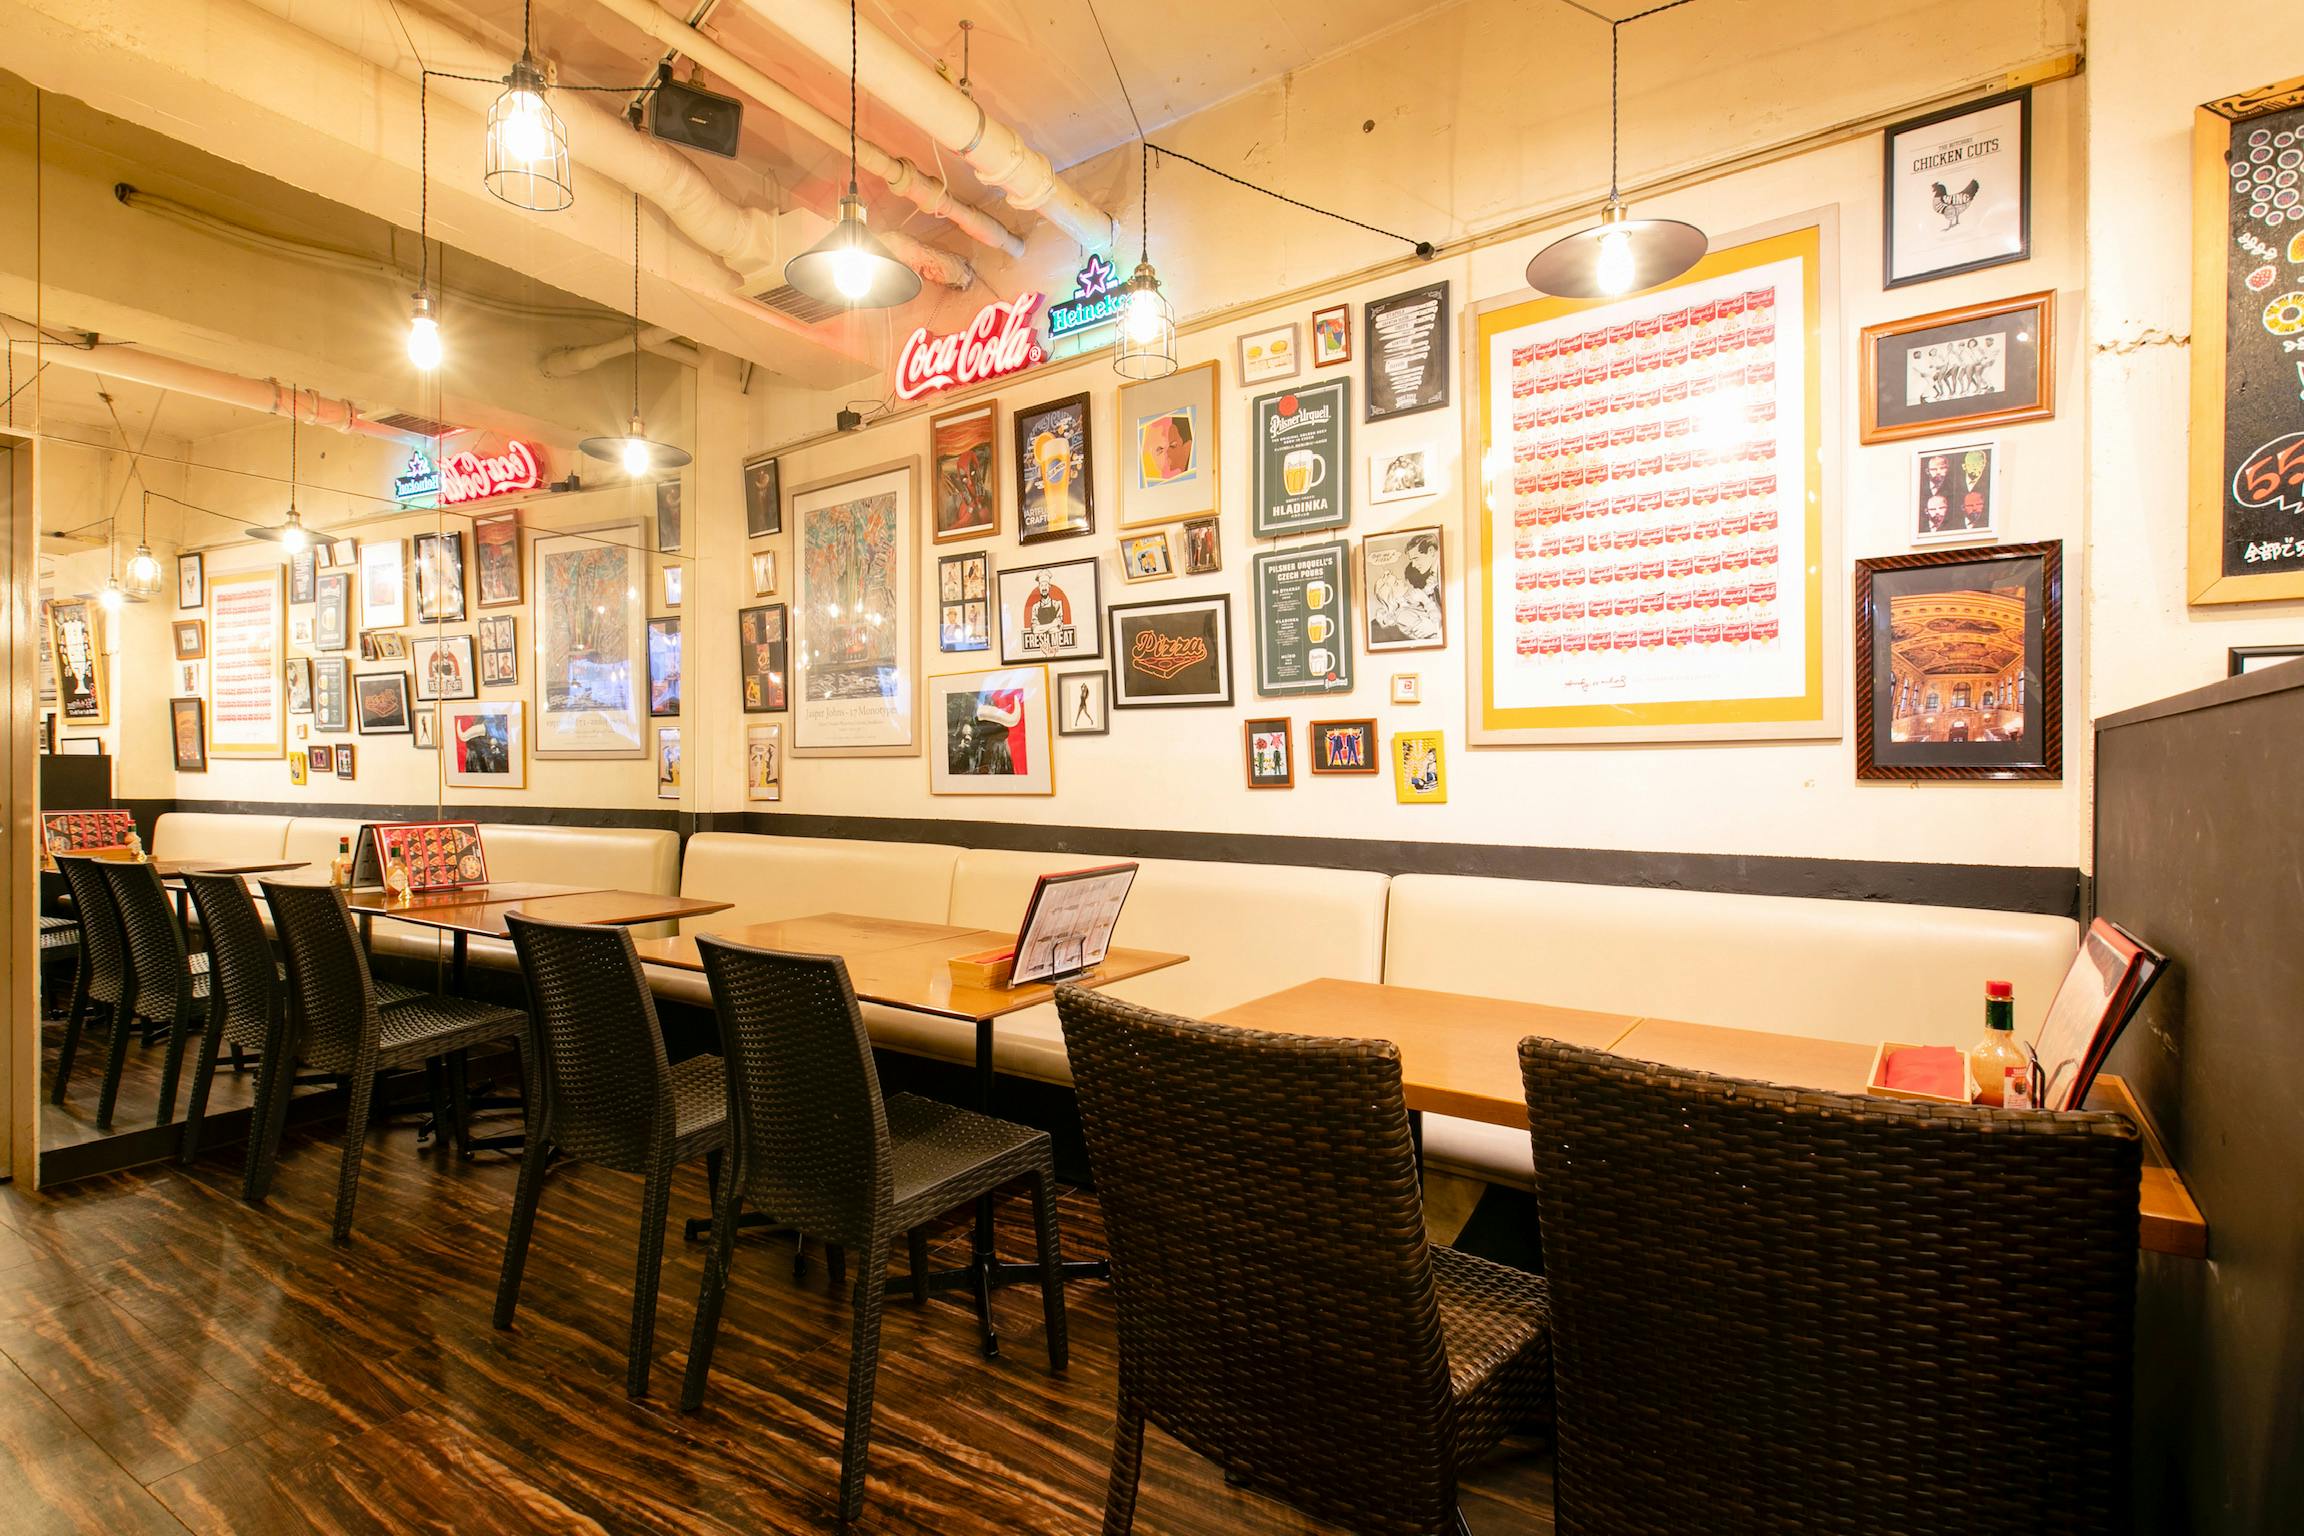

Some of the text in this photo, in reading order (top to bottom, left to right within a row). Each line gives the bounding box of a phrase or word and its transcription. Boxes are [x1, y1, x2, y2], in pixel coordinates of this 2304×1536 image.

[1913, 138, 2000, 172] CHICKEN CUTS
[1942, 193, 1970, 205] WING
[1052, 292, 1136, 333] Heineke
[1270, 404, 1329, 439] Pilsner Urquell
[1272, 498, 1328, 517] HLADINKA
[1268, 557, 1333, 574] PILSNER URQUELL'S
[1277, 571, 1299, 581] CZECH
[1300, 568, 1324, 578] POURS
[1024, 631, 1074, 648] FRESH MEAT
[1132, 630, 1207, 659] Pizza
